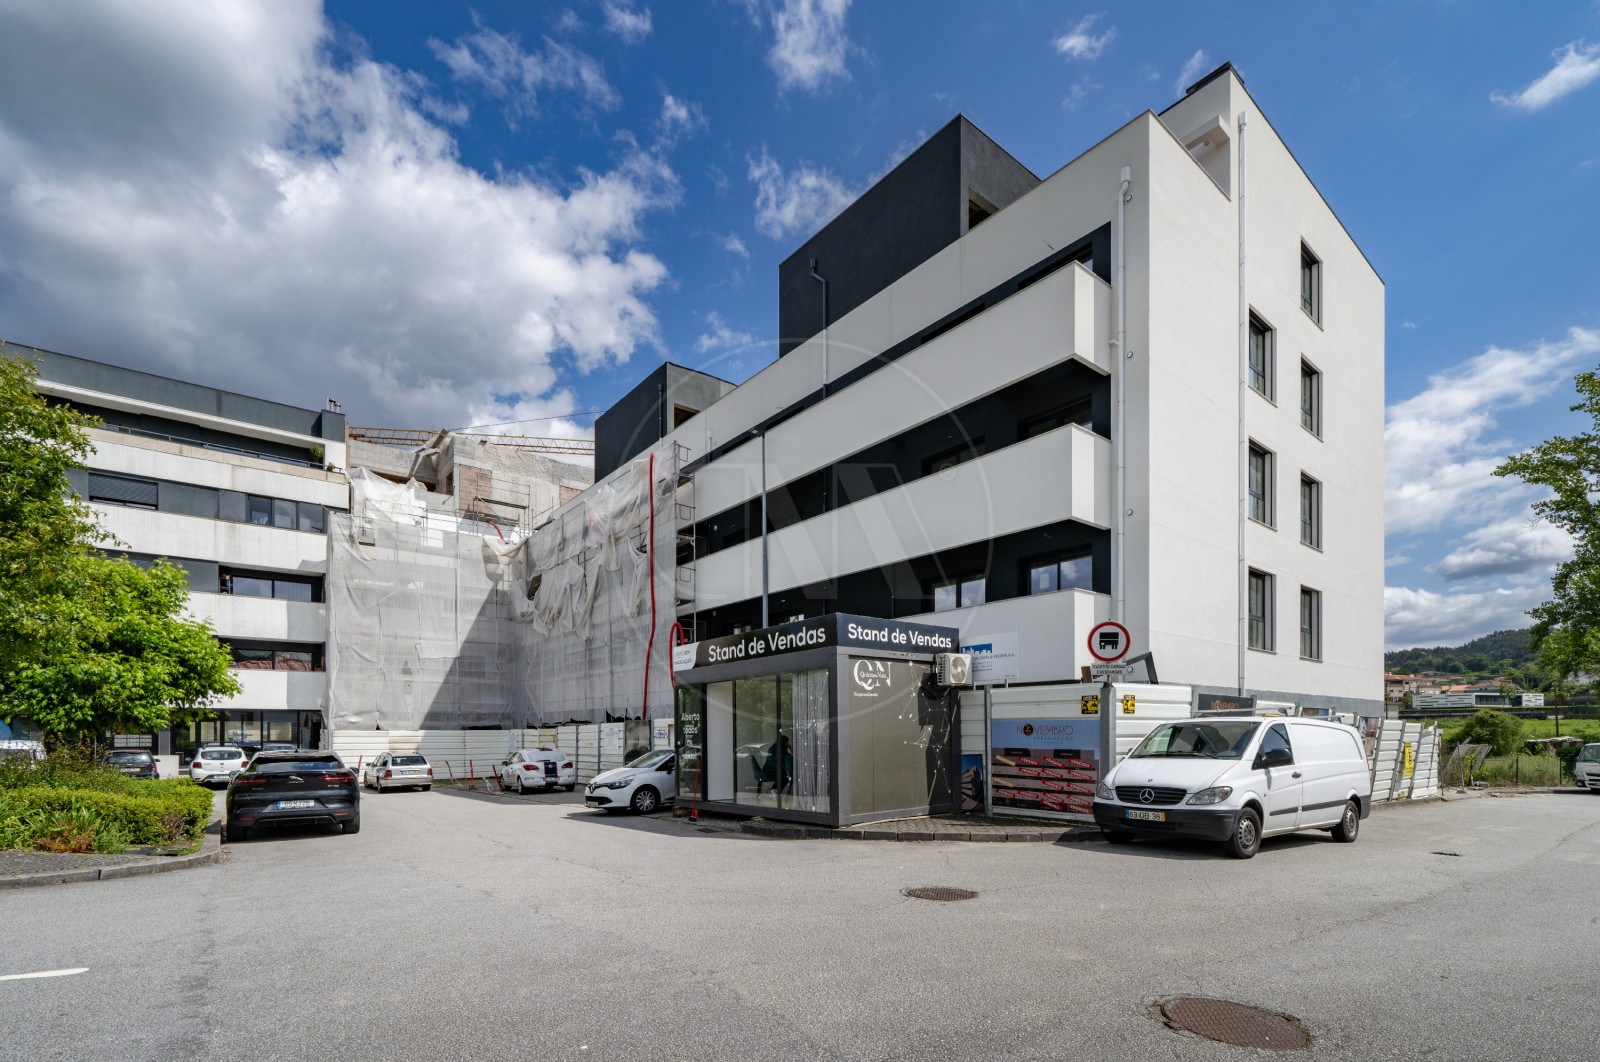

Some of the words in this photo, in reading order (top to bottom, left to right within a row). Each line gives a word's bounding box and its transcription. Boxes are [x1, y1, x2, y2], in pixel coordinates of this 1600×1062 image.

[708, 639, 745, 663] Stand
[748, 636, 766, 656] de
[768, 626, 827, 651] Vendas
[848, 623, 888, 642] Stand
[891, 628, 907, 644] de
[909, 630, 952, 648] Vendas
[681, 713, 700, 721] Aberto
